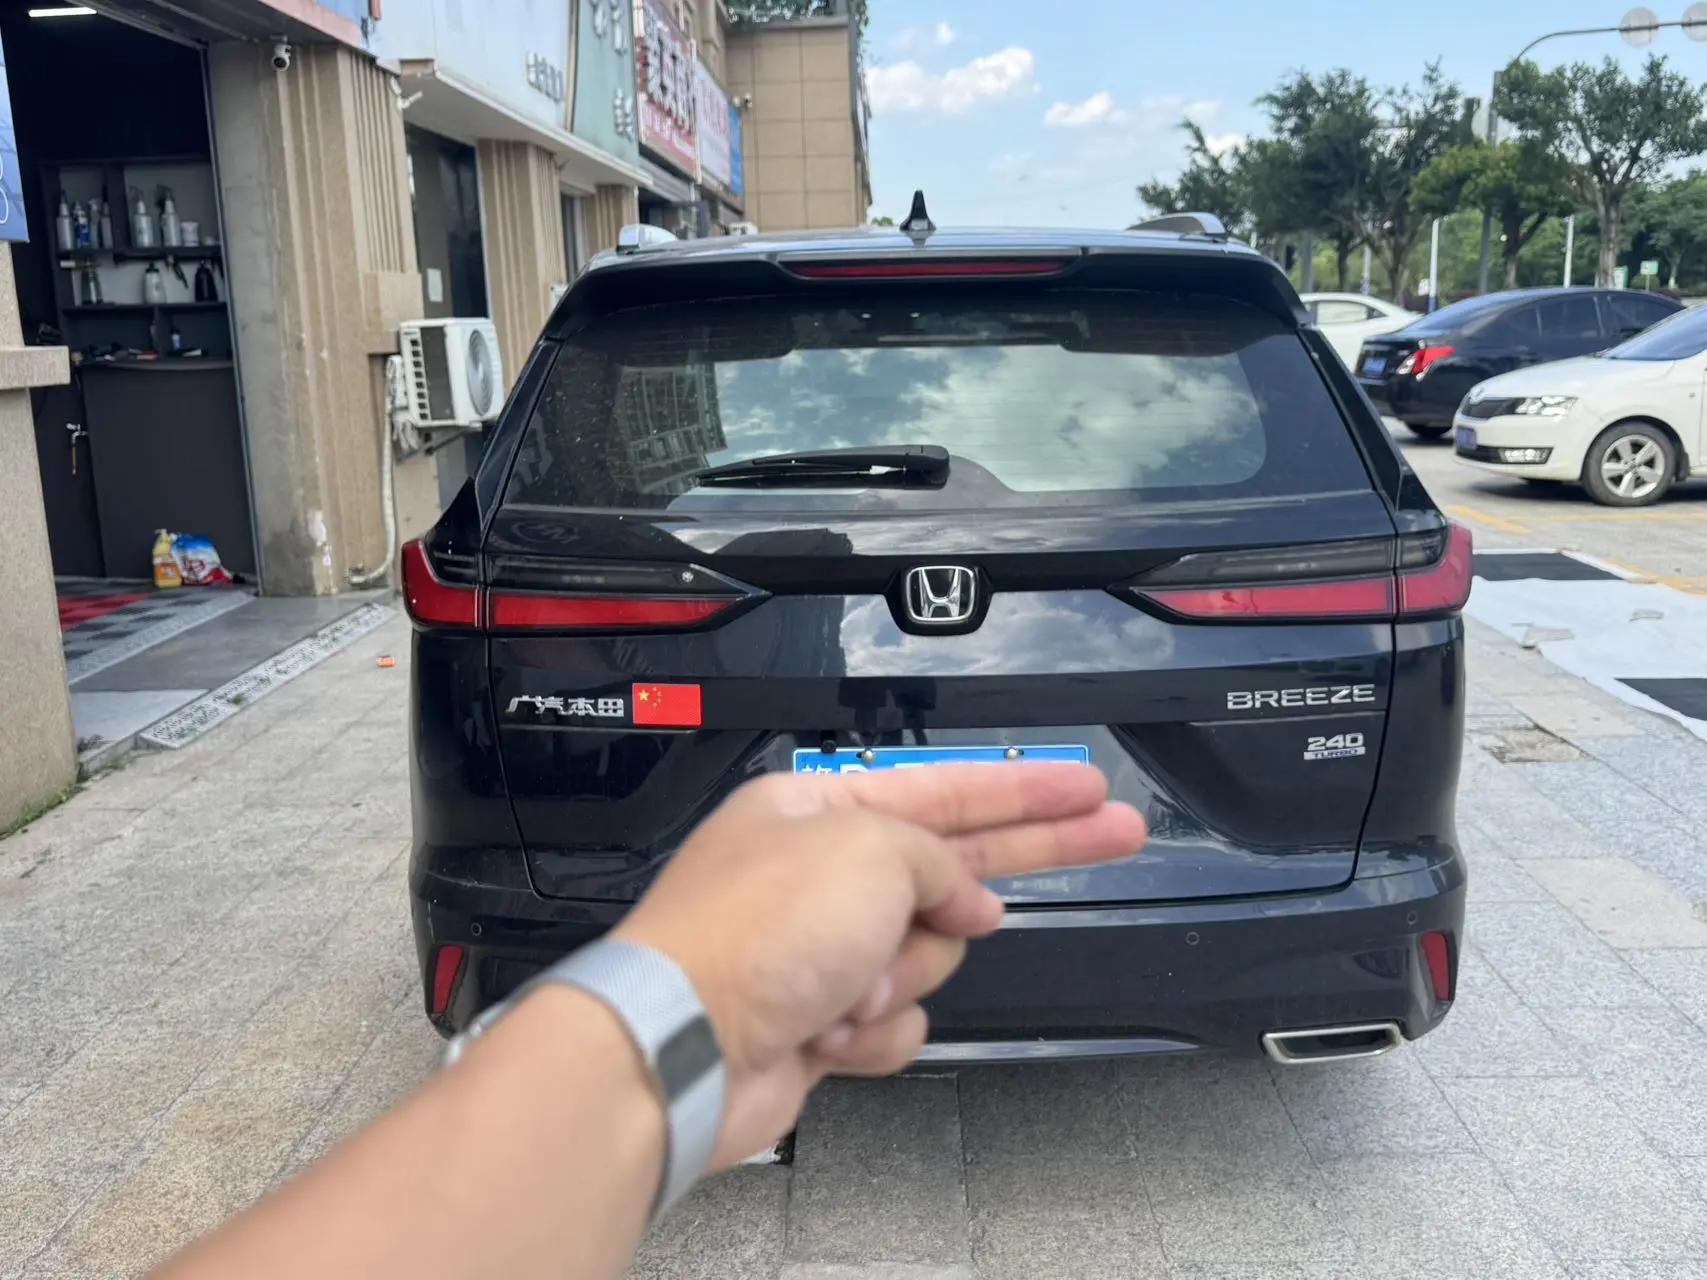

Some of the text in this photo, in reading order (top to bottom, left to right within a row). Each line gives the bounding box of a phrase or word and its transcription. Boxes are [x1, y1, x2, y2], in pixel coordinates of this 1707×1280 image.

[505, 695, 624, 717] 广汽本田
[1227, 684, 1375, 709] BREEZE
[1307, 732, 1364, 751] 240
